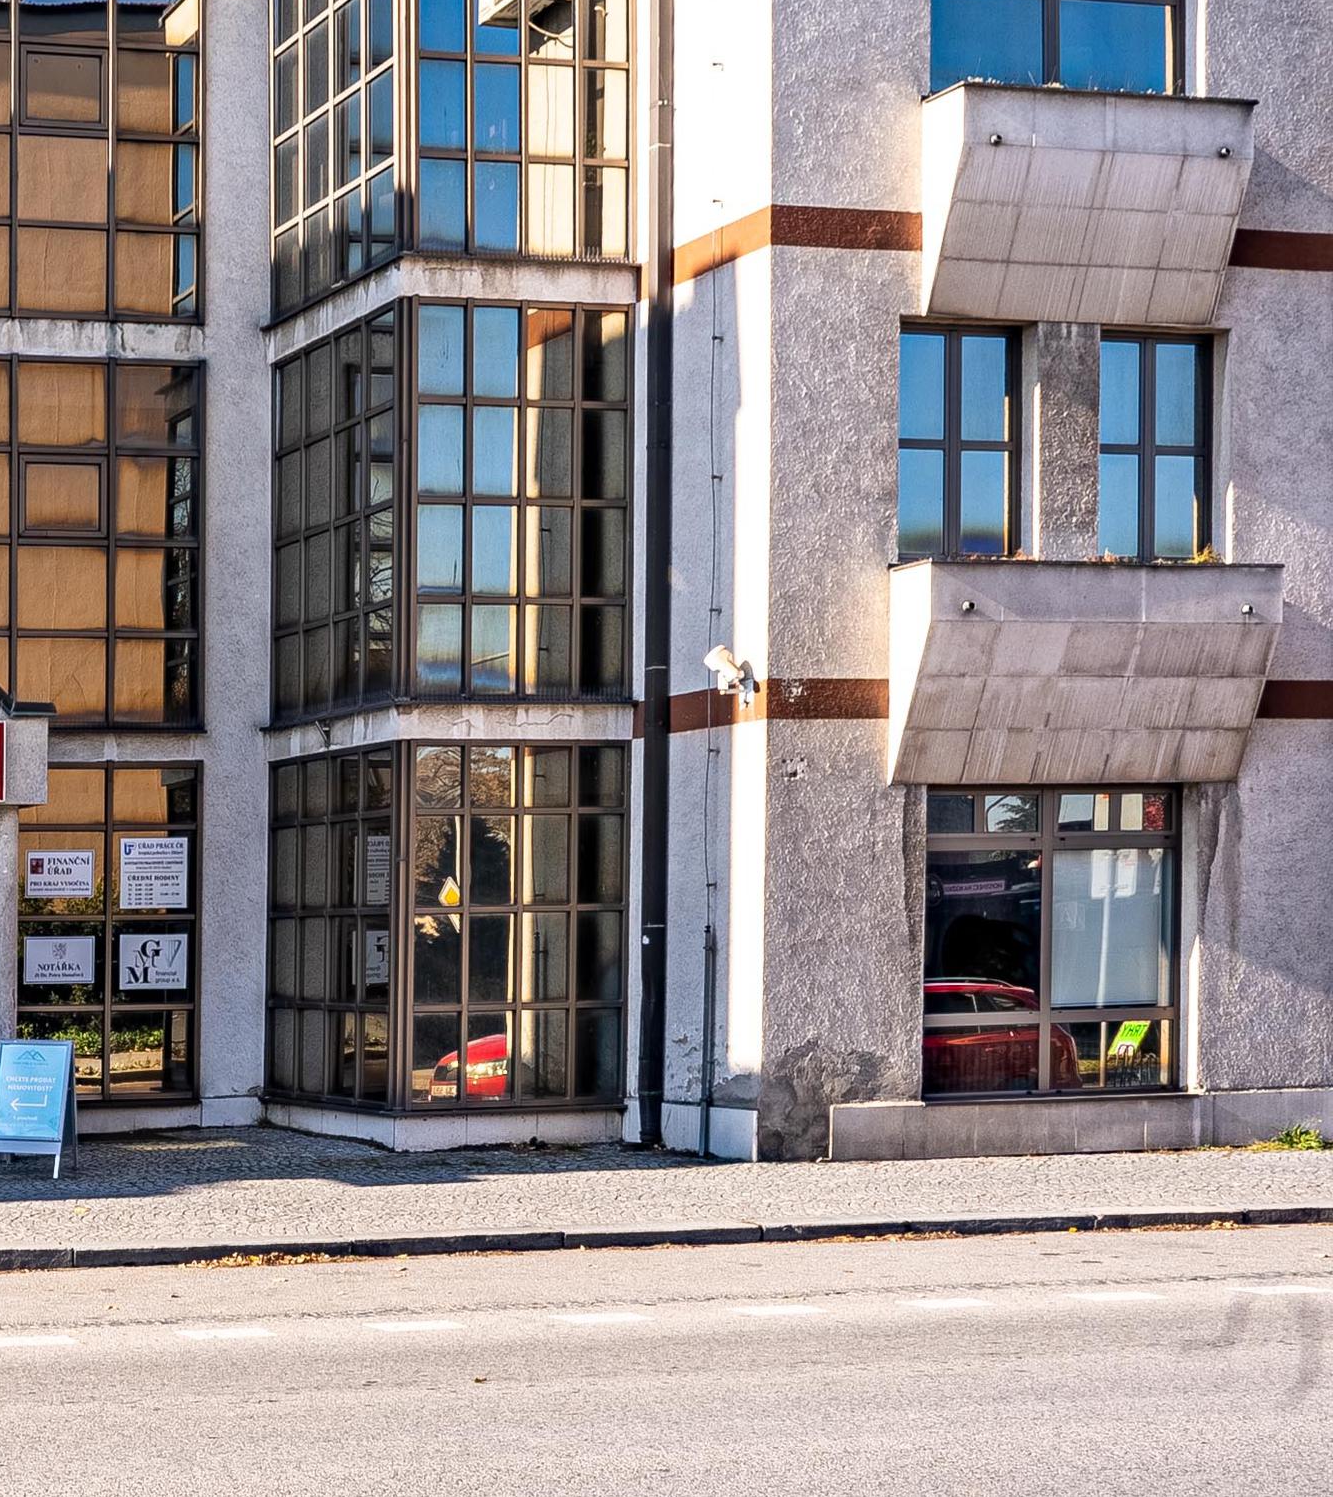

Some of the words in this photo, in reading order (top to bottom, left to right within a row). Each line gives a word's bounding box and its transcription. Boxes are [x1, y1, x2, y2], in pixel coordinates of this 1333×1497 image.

[48, 856, 89, 865] FINANČNÍ
[48, 866, 72, 875] ÚŘAD
[37, 961, 81, 971] NOTÁŘKA
